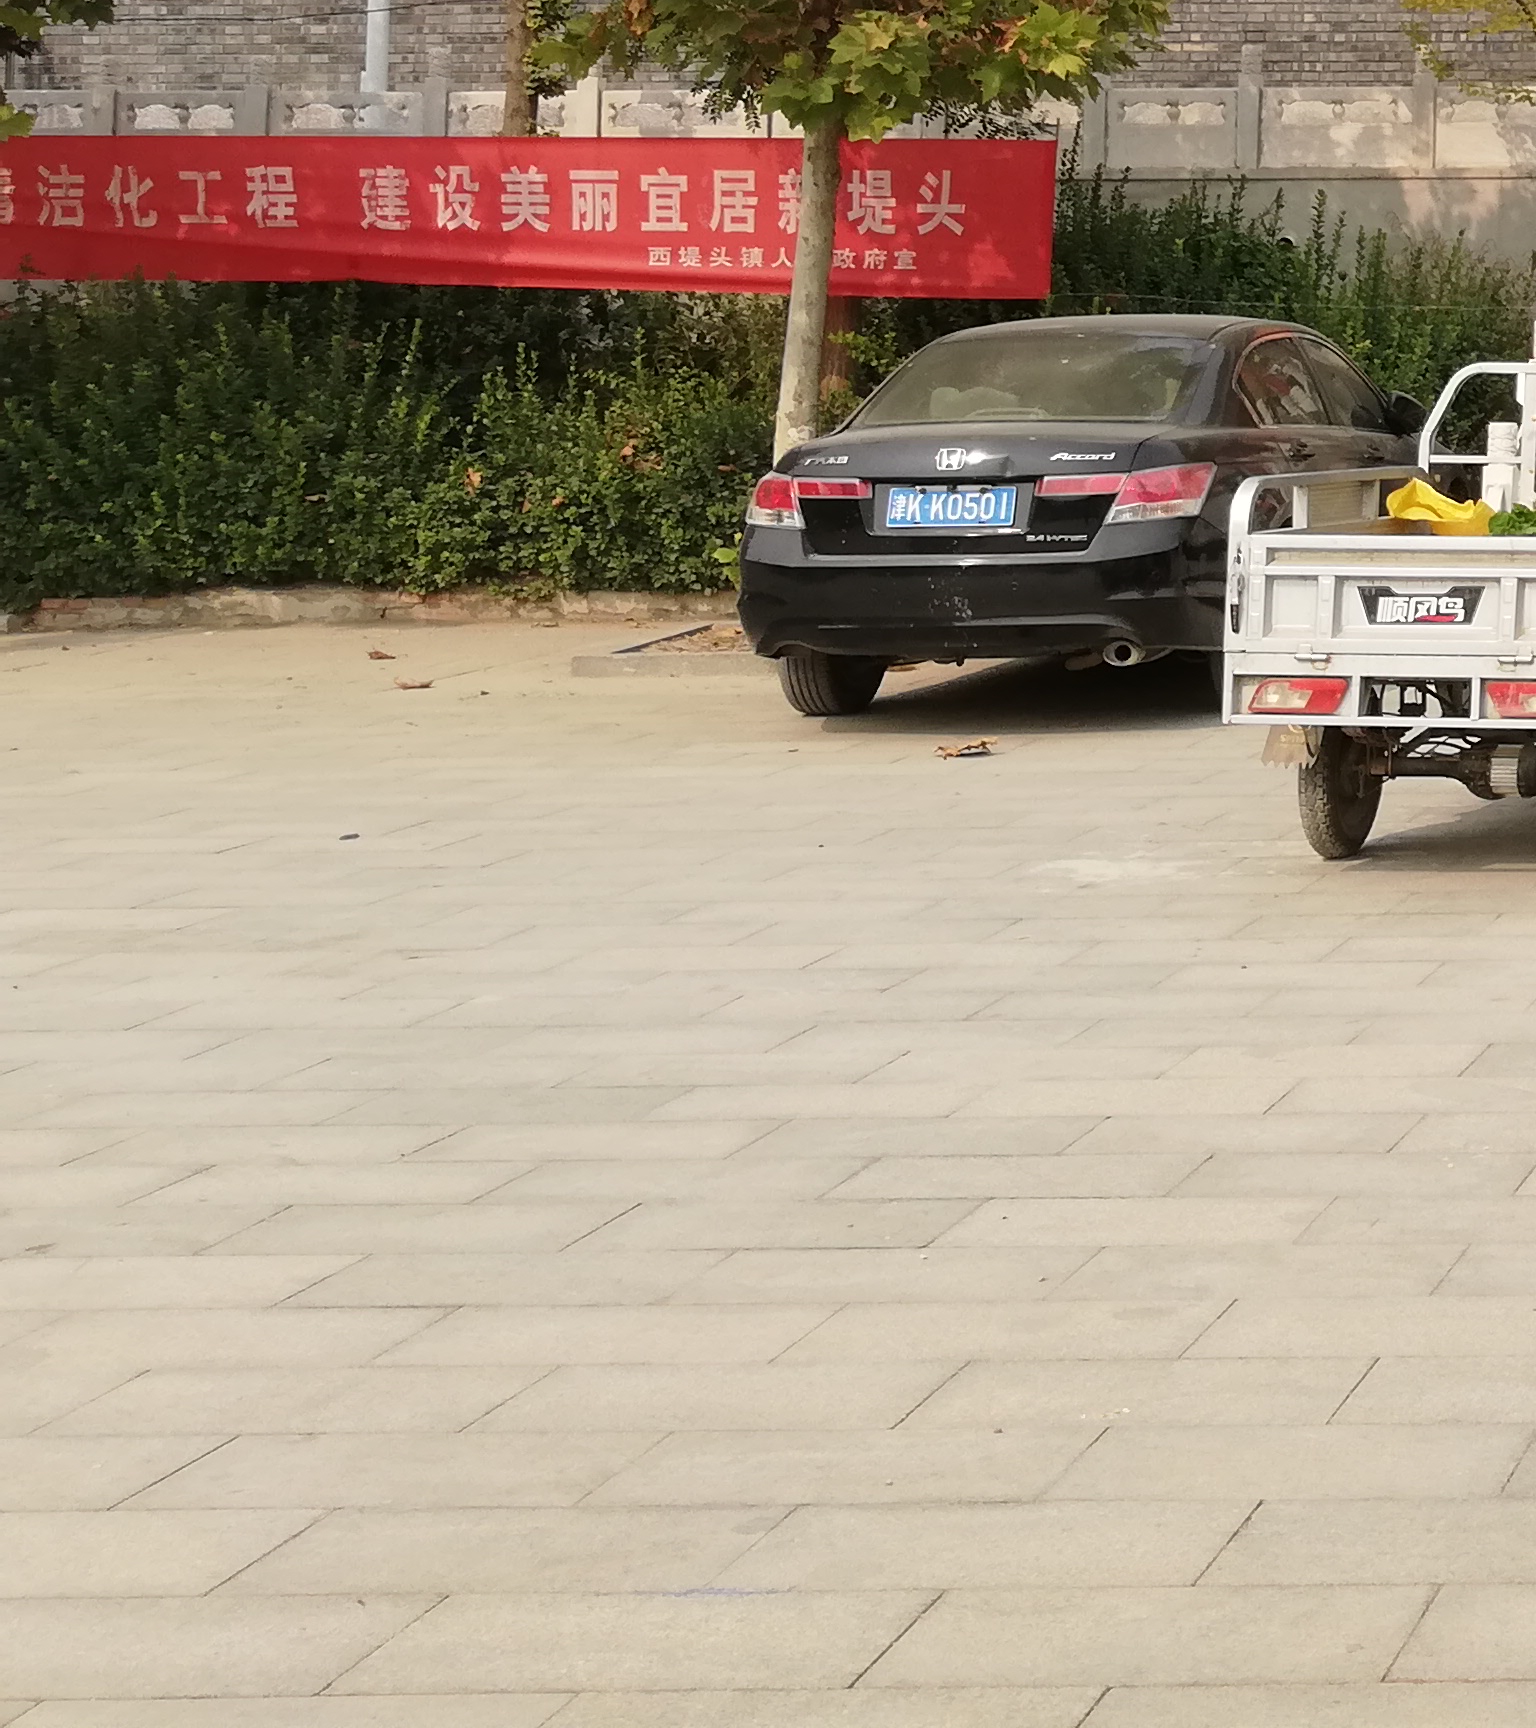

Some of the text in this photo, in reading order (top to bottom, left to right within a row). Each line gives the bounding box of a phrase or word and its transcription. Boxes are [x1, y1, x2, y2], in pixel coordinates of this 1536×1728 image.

[647, 244, 918, 271] 西堤头镇人政府宣
[1050, 452, 1116, 461] Accord
[1376, 596, 1466, 623] 顺风鸟
